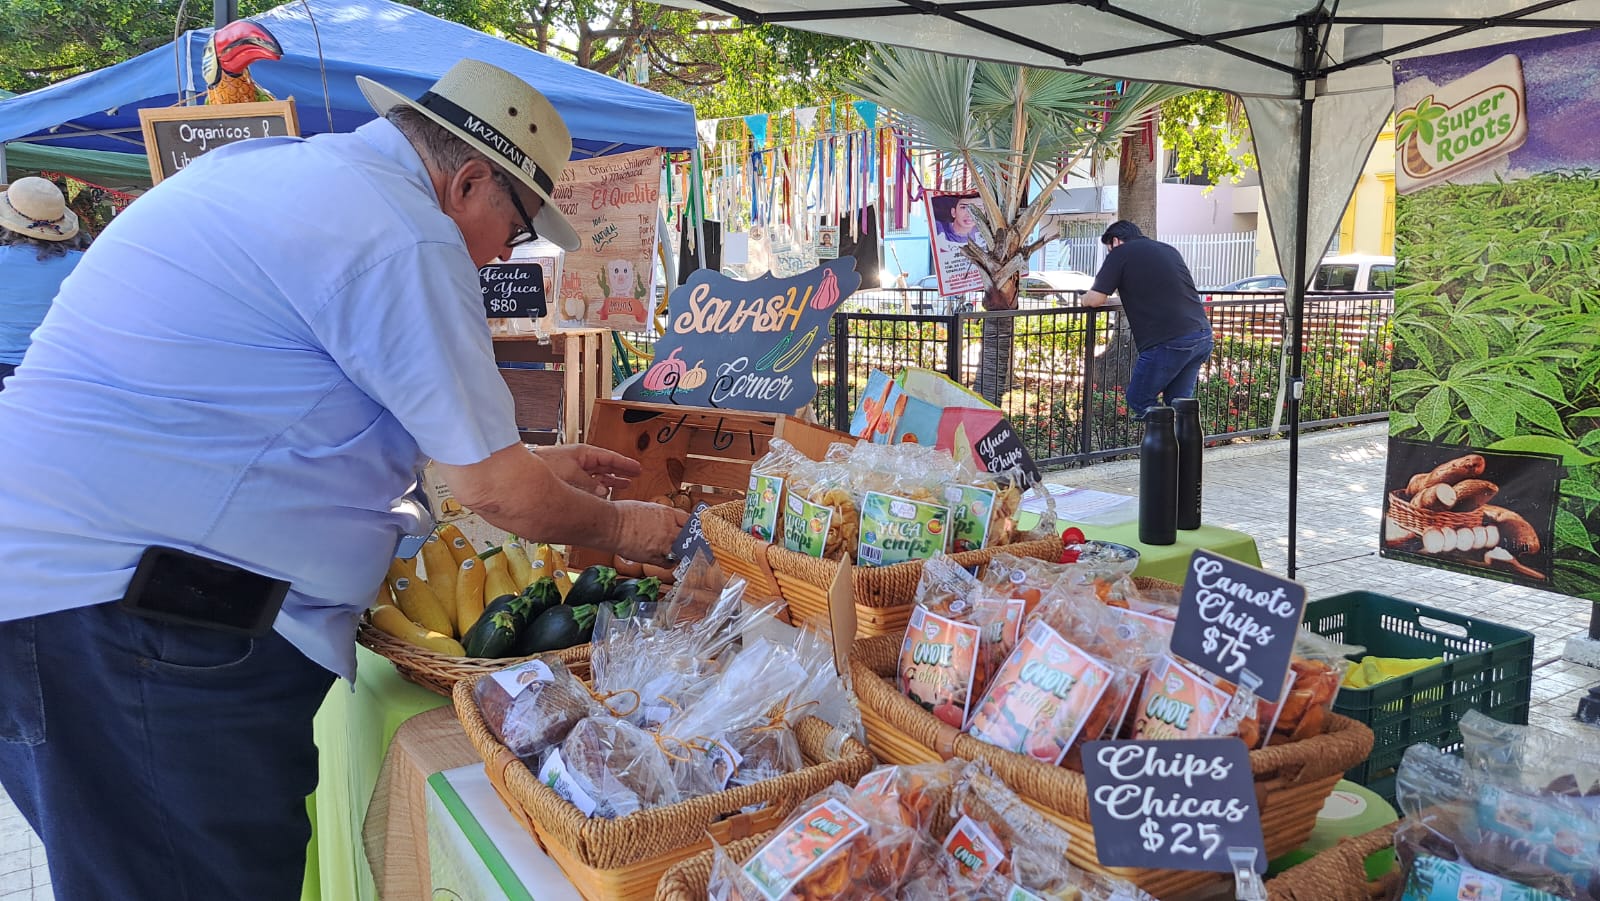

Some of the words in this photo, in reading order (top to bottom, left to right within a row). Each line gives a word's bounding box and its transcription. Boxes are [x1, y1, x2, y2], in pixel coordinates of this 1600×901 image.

[179, 123, 251, 151] Organicos
[1436, 113, 1511, 162] Roots
[591, 188, 608, 211] El
[609, 182, 657, 210] Quelite
[638, 213, 650, 226] The
[490, 297, 518, 313] $80
[493, 281, 541, 299] Yuca
[673, 282, 814, 335] SQUASH
[711, 356, 794, 403] Corner
[980, 429, 1011, 459] Yuca
[987, 447, 1023, 473] Chips
[878, 520, 923, 538] YUCA
[1193, 556, 1296, 618] Camote
[1195, 589, 1276, 646] Chips
[1201, 625, 1252, 673] $75
[1096, 744, 1234, 788] Chips
[1094, 783, 1250, 823] Chicas
[1138, 816, 1224, 861] $25
